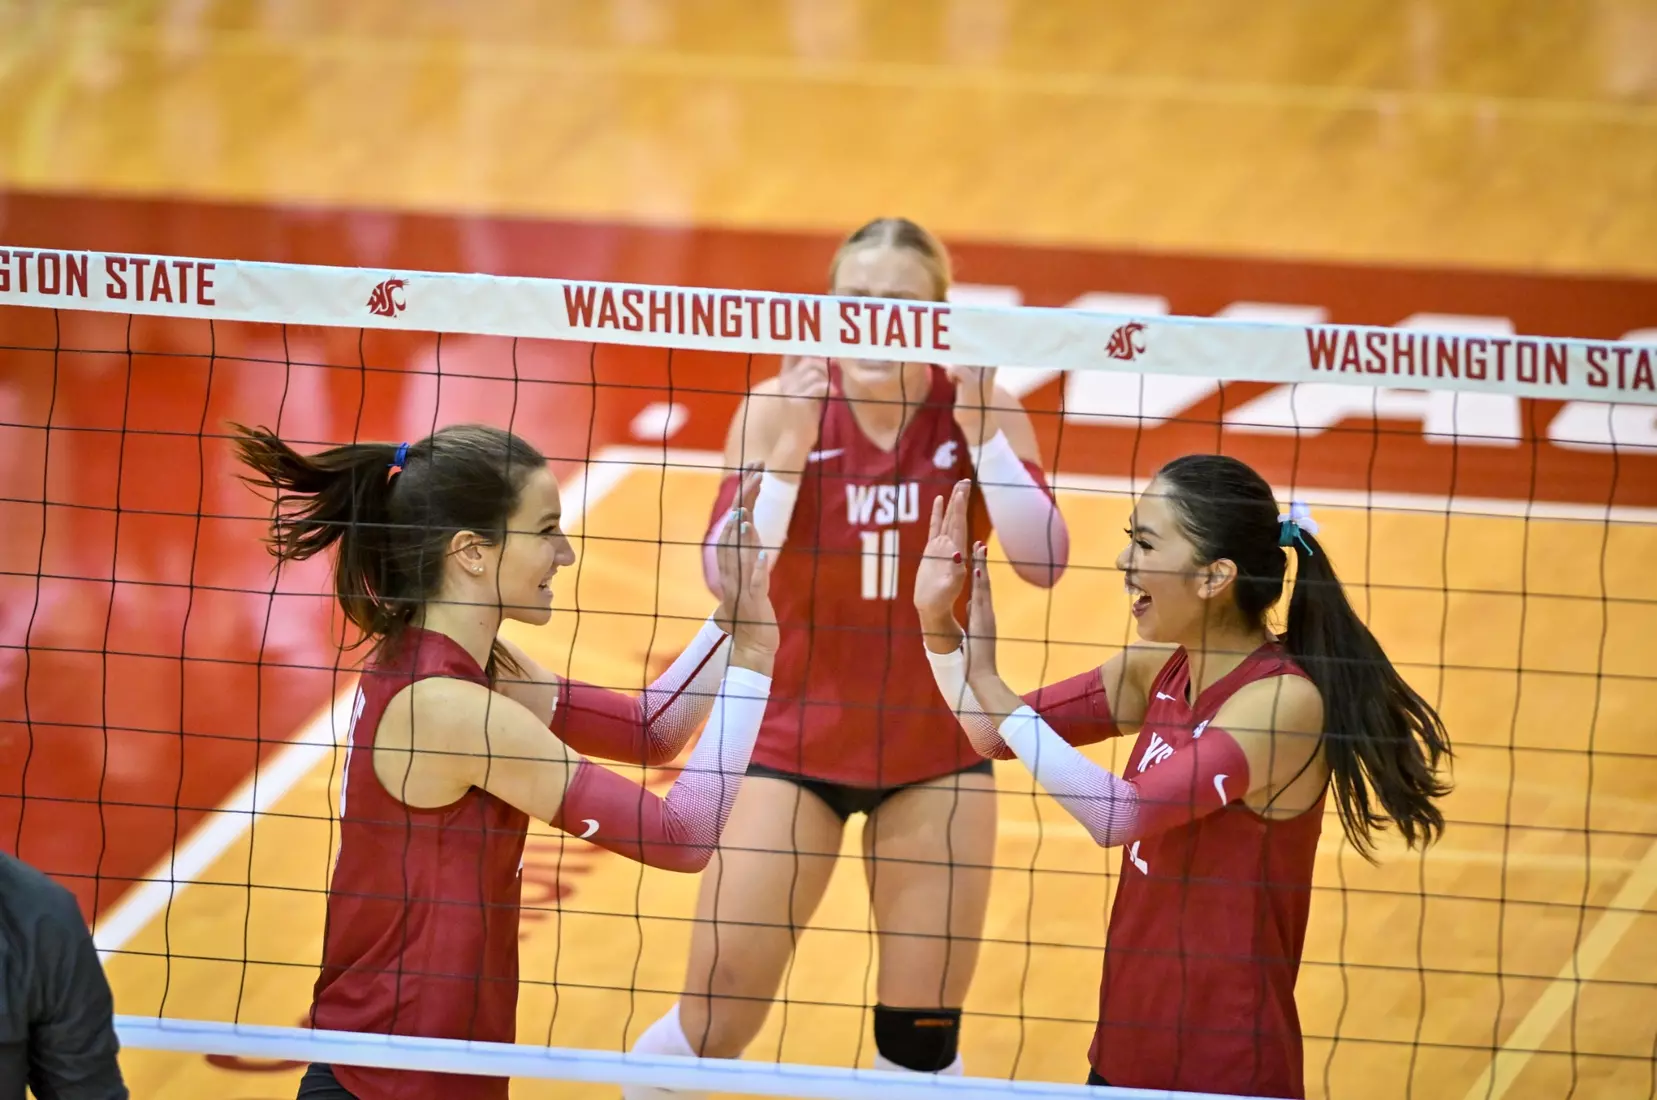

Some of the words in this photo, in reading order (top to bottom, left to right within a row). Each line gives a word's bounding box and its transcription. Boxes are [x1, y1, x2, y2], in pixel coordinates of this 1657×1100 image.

[105, 256, 216, 306] STATE
[562, 284, 822, 342] WASHINGTON
[839, 302, 951, 351] STATE
[1305, 327, 1569, 385] WASHINGTON
[1586, 345, 1657, 392] STA
[846, 482, 919, 525] WSU
[860, 529, 900, 600] 11
